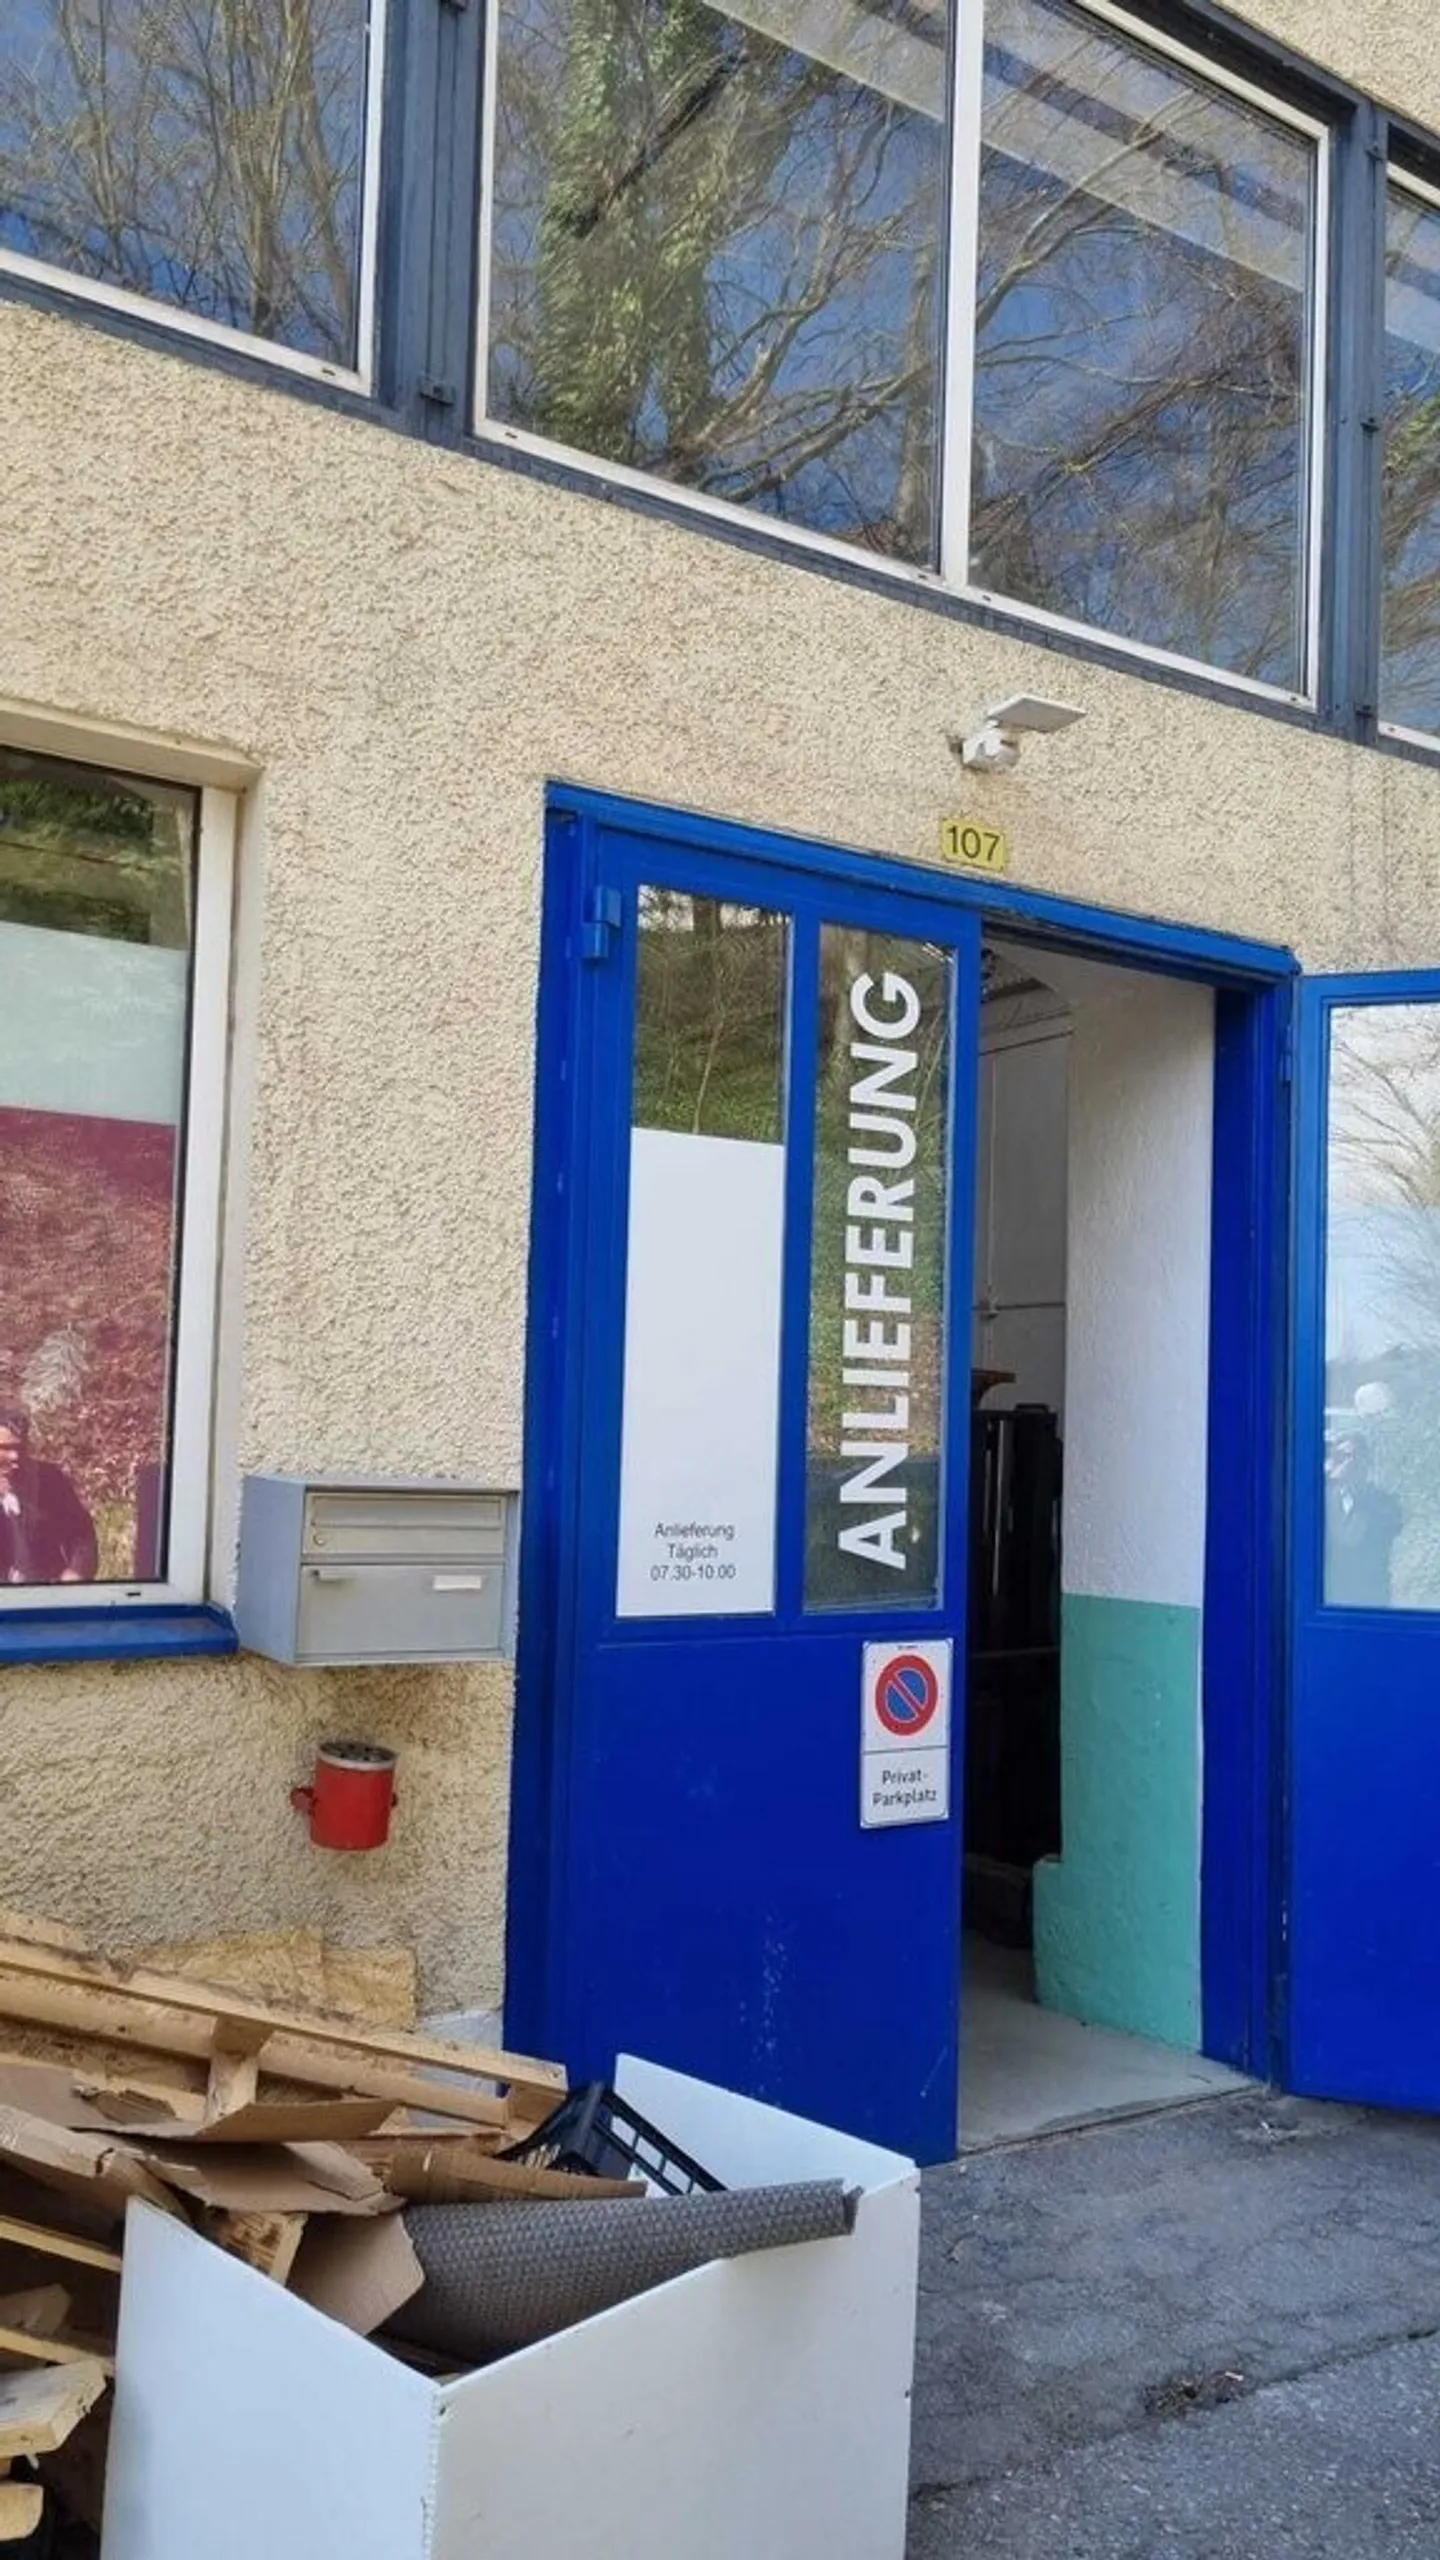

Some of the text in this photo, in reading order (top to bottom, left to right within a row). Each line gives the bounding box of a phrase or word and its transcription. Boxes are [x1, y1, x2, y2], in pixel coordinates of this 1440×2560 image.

[946, 825, 1000, 861] 107
[838, 971, 921, 1569] ANLIEFERUNG
[654, 1521, 735, 1541] Anlieferung
[668, 1543, 718, 1562] Täglich
[882, 1769, 929, 1784] Privat-
[872, 1788, 937, 1807] Parkplatz
